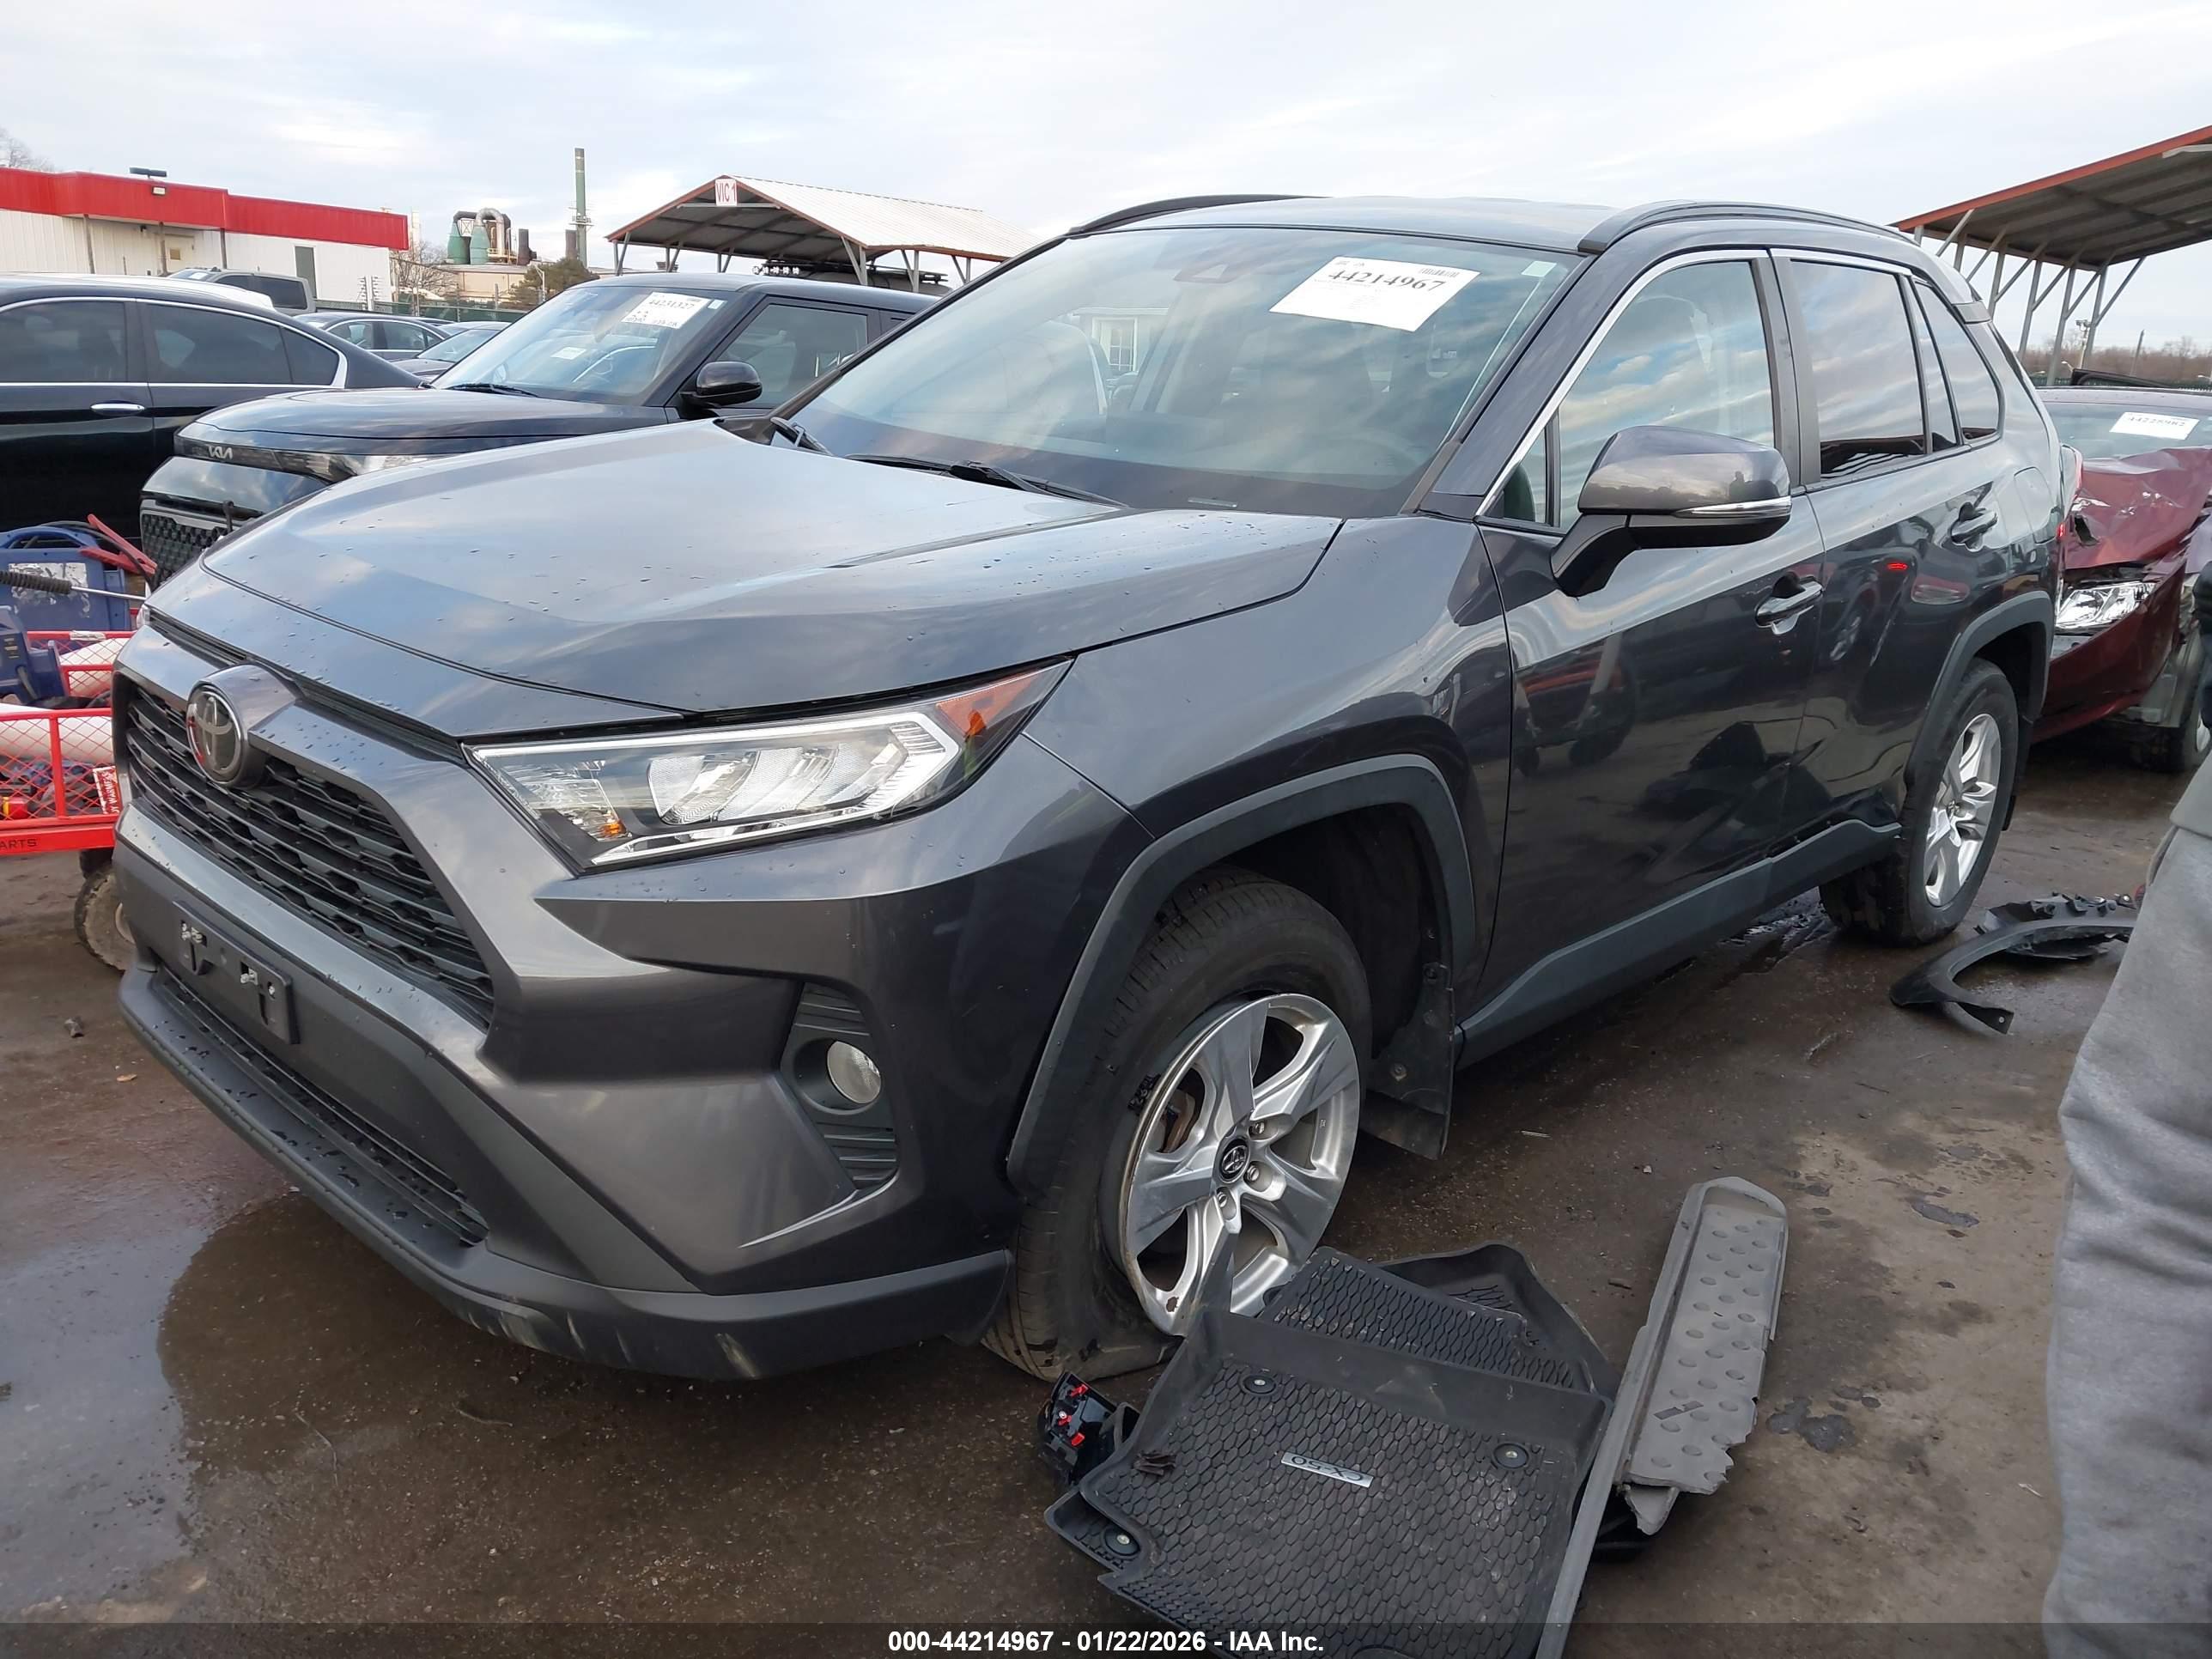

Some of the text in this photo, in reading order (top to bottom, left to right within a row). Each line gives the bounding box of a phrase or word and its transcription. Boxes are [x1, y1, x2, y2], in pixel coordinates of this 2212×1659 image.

[716, 182, 736, 202] VIC 1
[1328, 270, 1446, 292] 44214967
[1291, 1455, 1363, 1481] CX-50
